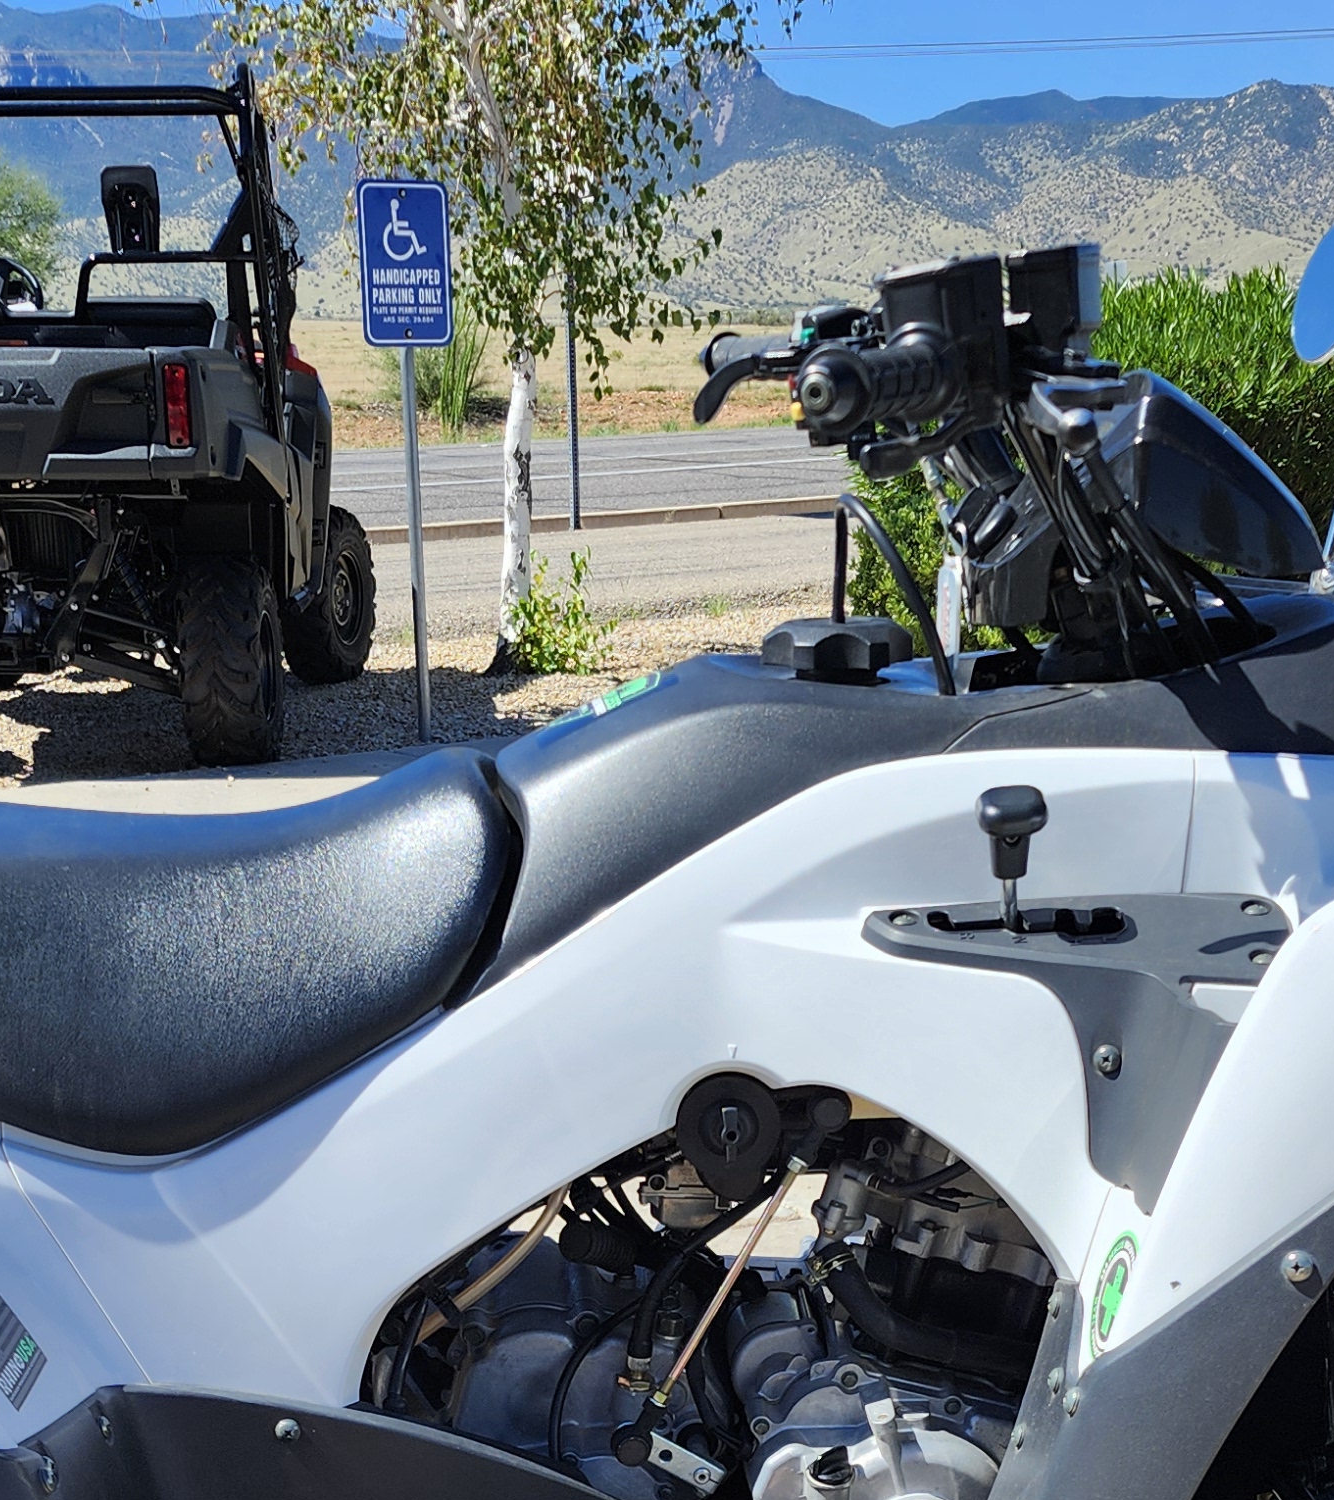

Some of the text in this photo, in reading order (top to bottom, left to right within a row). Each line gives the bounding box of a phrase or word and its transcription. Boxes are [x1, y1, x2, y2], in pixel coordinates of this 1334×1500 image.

[372, 268, 440, 285] HANDICAPPED
[372, 287, 442, 304] PARKING ONLY
